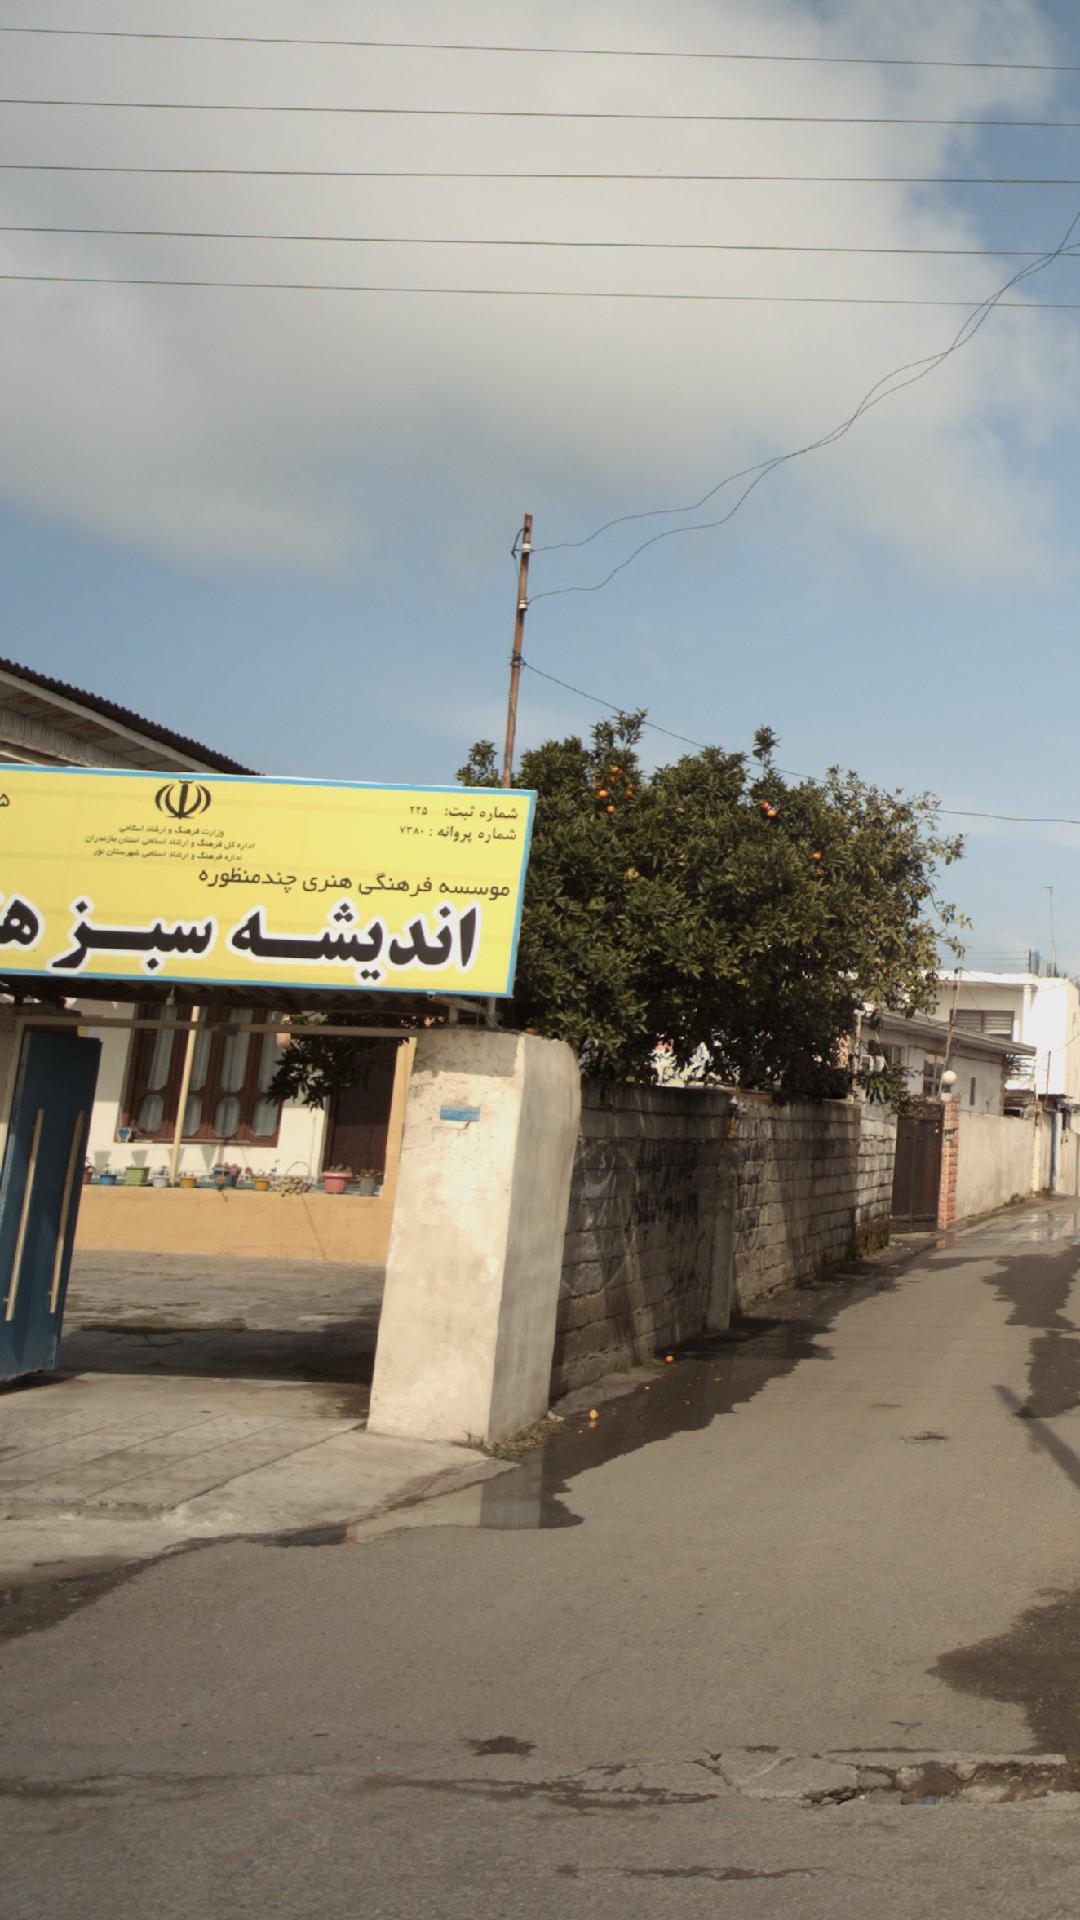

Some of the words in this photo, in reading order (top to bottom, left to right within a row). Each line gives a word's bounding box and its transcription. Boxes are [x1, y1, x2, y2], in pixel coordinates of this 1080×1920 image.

[479, 806, 518, 822] شماره
[437, 825, 472, 843] پروانه
[478, 827, 517, 844] شماره
[303, 874, 353, 893] هنری
[358, 874, 433, 897] فرهنگی
[439, 881, 511, 900] موسسه
[50, 899, 213, 971] سبز
[231, 903, 477, 981] اندیشه
